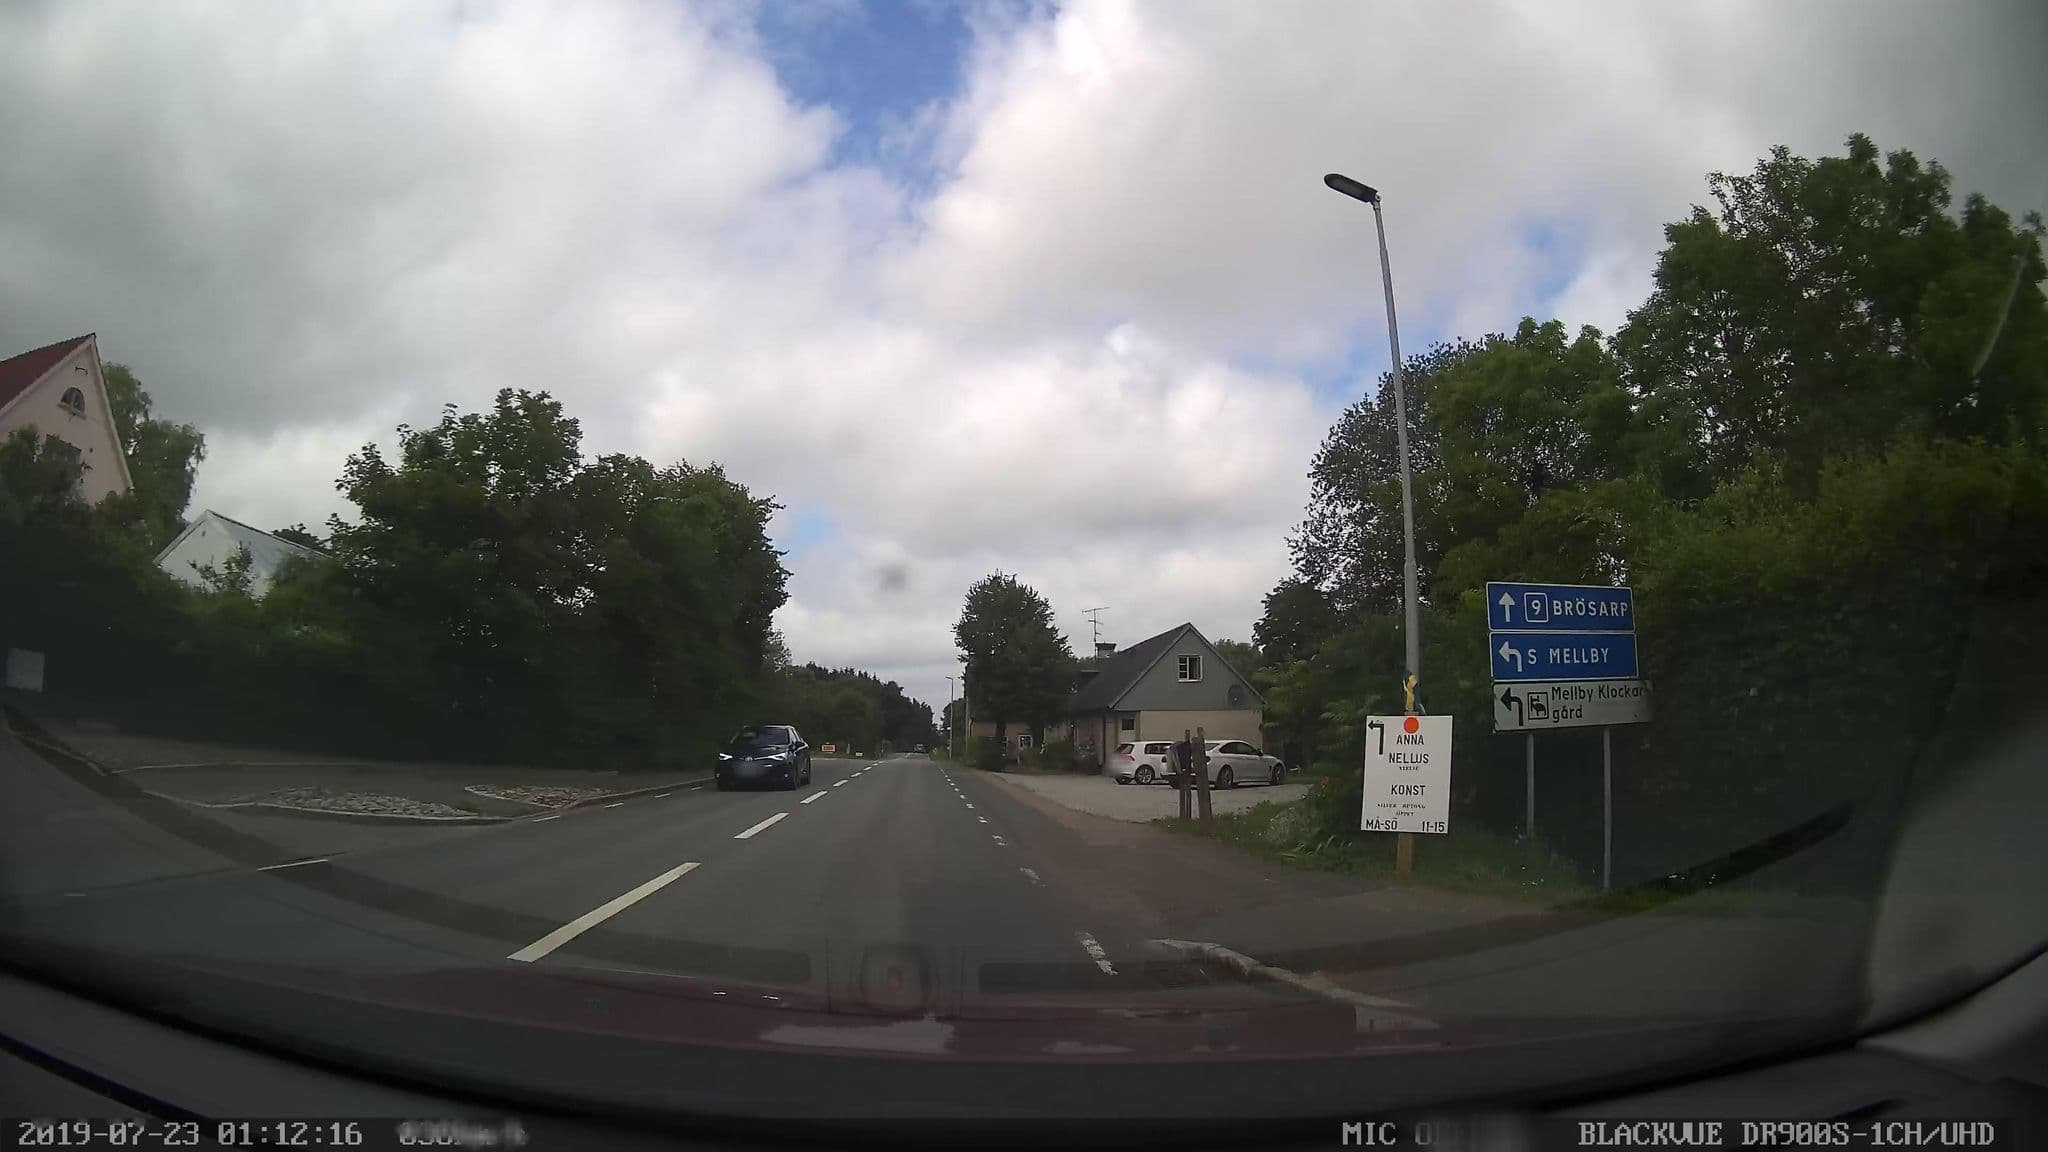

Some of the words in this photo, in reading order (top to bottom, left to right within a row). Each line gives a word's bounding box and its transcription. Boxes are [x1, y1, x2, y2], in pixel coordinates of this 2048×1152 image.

[1531, 600, 1541, 615] 9
[1553, 598, 1628, 617] BRÖSARP
[1527, 649, 1537, 665] S
[1549, 648, 1609, 664] MELLBY
[1552, 686, 1594, 702] Mellby
[1552, 705, 1583, 723] gård
[1396, 734, 1424, 745] ANNA
[1389, 752, 1429, 763] NELLUS
[1391, 785, 1426, 795] KONST
[1421, 821, 1445, 832] 11-15
